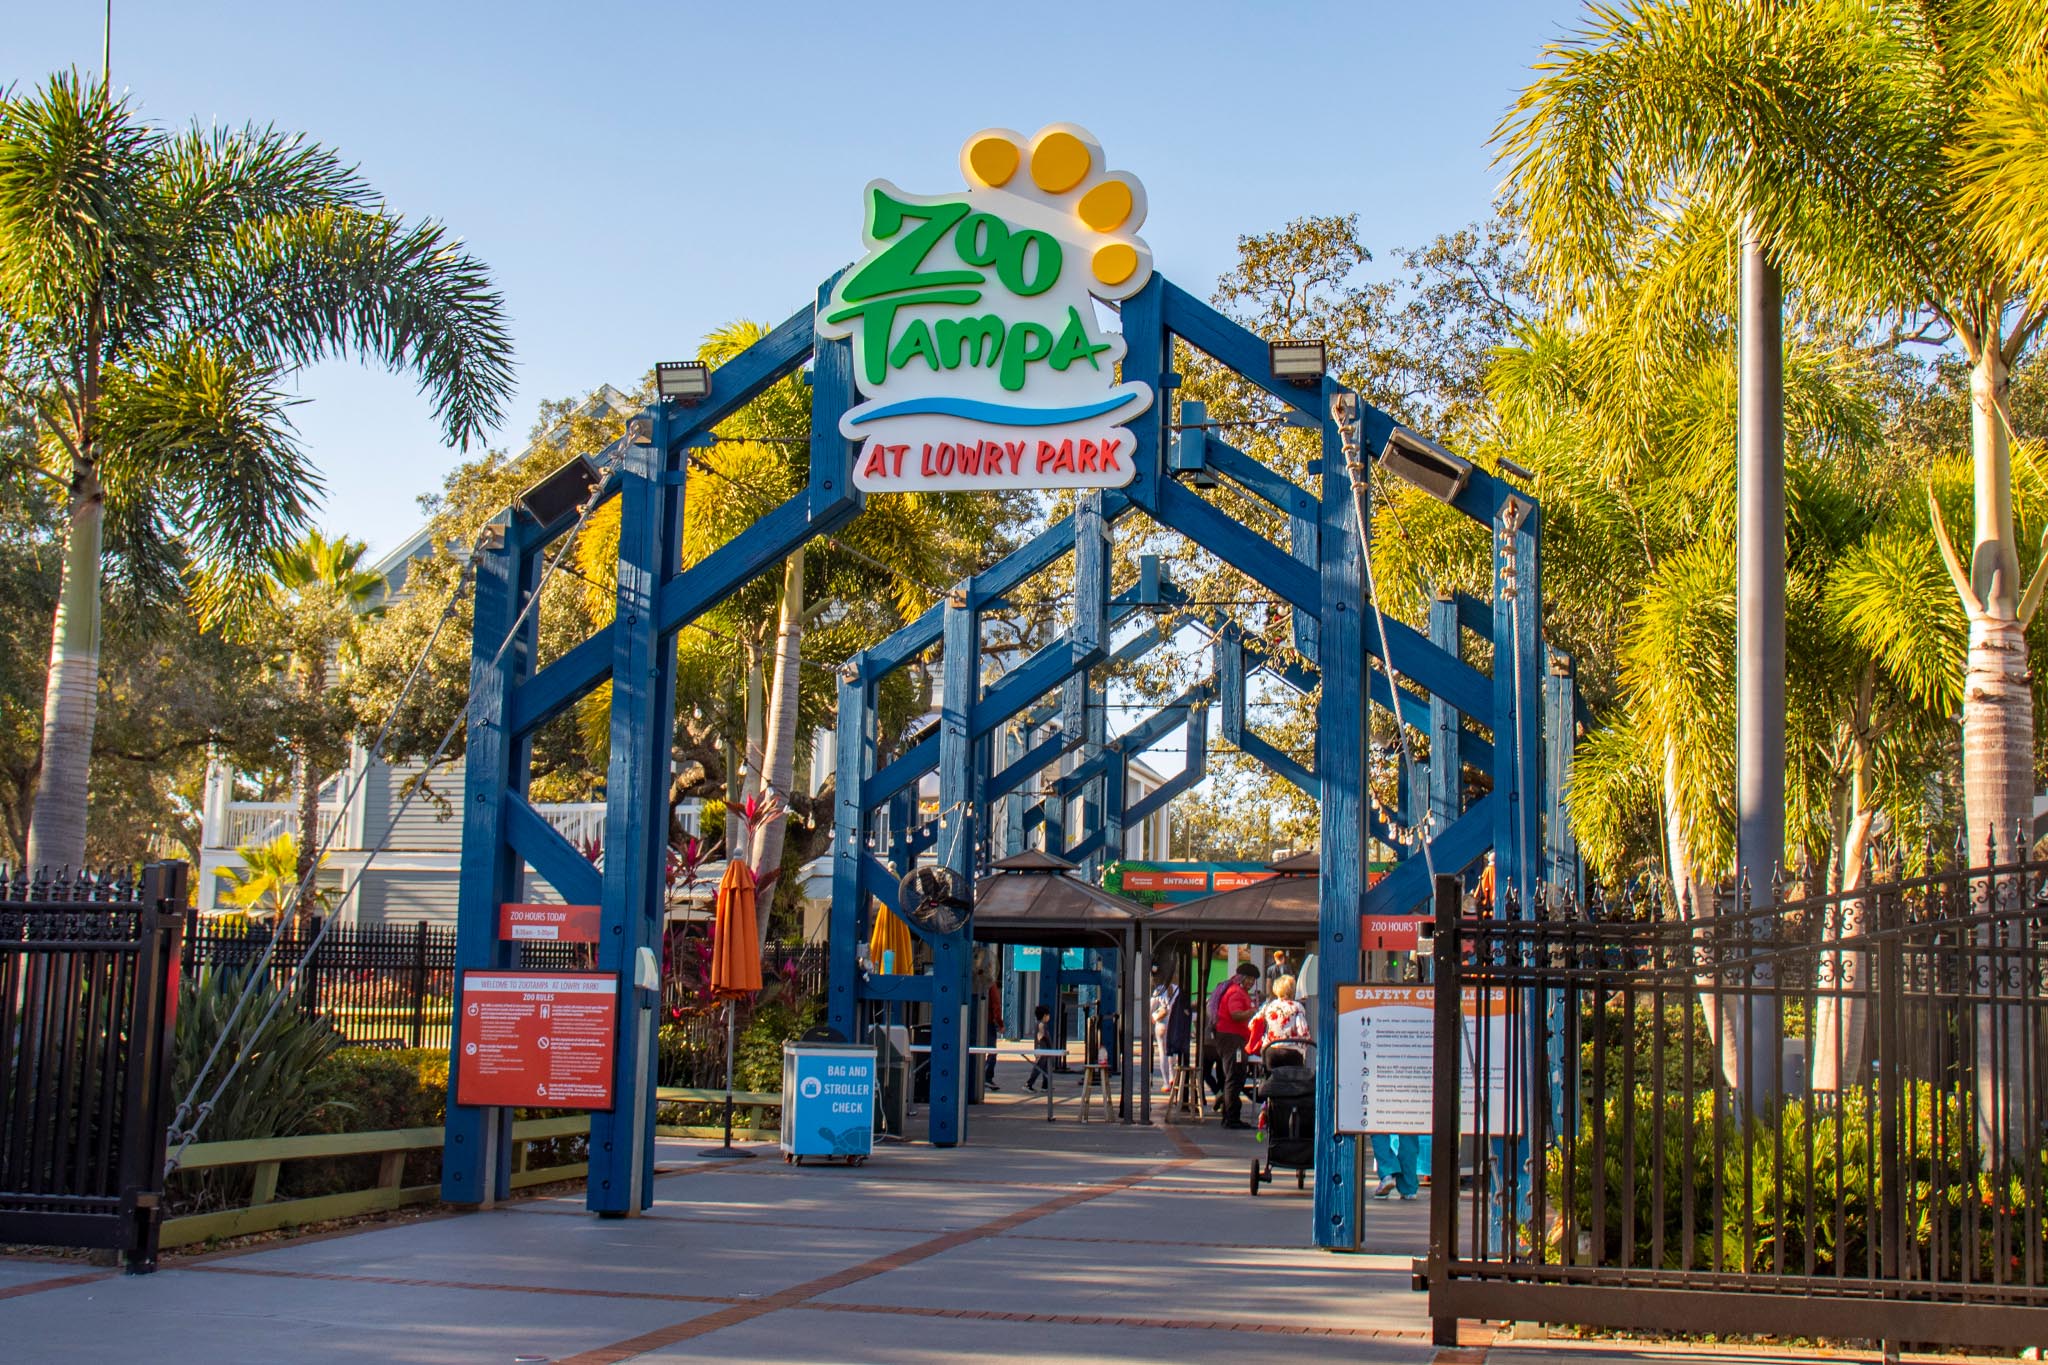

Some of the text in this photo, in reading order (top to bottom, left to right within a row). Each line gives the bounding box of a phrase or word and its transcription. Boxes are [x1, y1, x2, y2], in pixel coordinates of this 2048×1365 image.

[864, 438, 1121, 478] AT LOWRY PARK
[1163, 877, 1204, 886] ENTRANCE
[510, 911, 567, 922] ZOO HOURS TODAY
[1371, 921, 1387, 932] ZOO
[1388, 922, 1413, 932] HOURS
[481, 980, 508, 989] WELCOME
[552, 982, 560, 990] AT
[561, 982, 581, 990] LOWRY
[523, 993, 555, 1001] ZOO RULES
[1355, 989, 1411, 1000] SAFETY
[827, 1065, 867, 1077] BAG AND
[824, 1083, 869, 1095] STROLLER
[832, 1102, 863, 1113] CHECK
